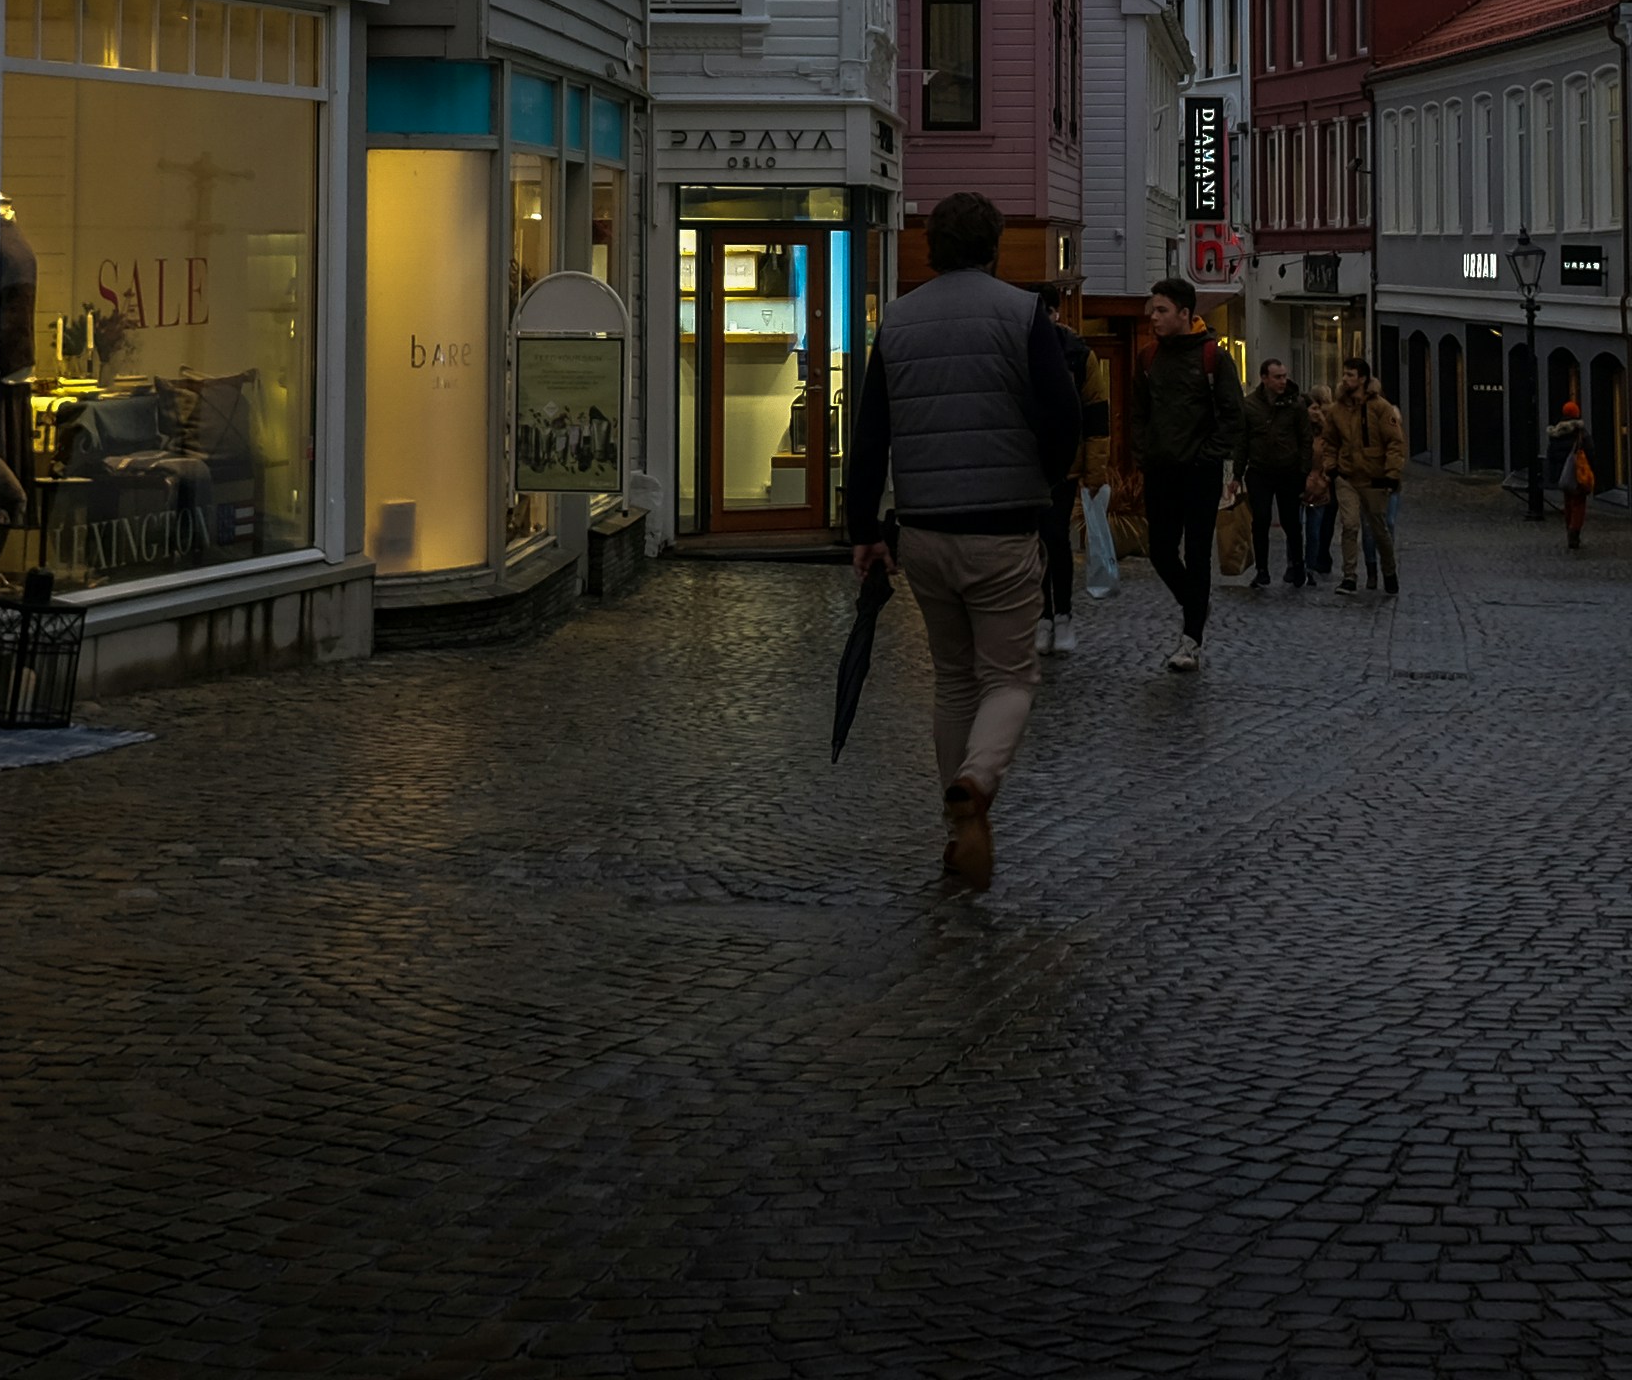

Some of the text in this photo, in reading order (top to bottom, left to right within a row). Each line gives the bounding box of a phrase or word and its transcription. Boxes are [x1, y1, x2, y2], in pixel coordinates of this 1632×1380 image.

[671, 129, 833, 150] PAPAYA
[727, 156, 777, 169] OSLO
[1201, 107, 1216, 210] DIAMANT
[98, 256, 210, 329] SALE
